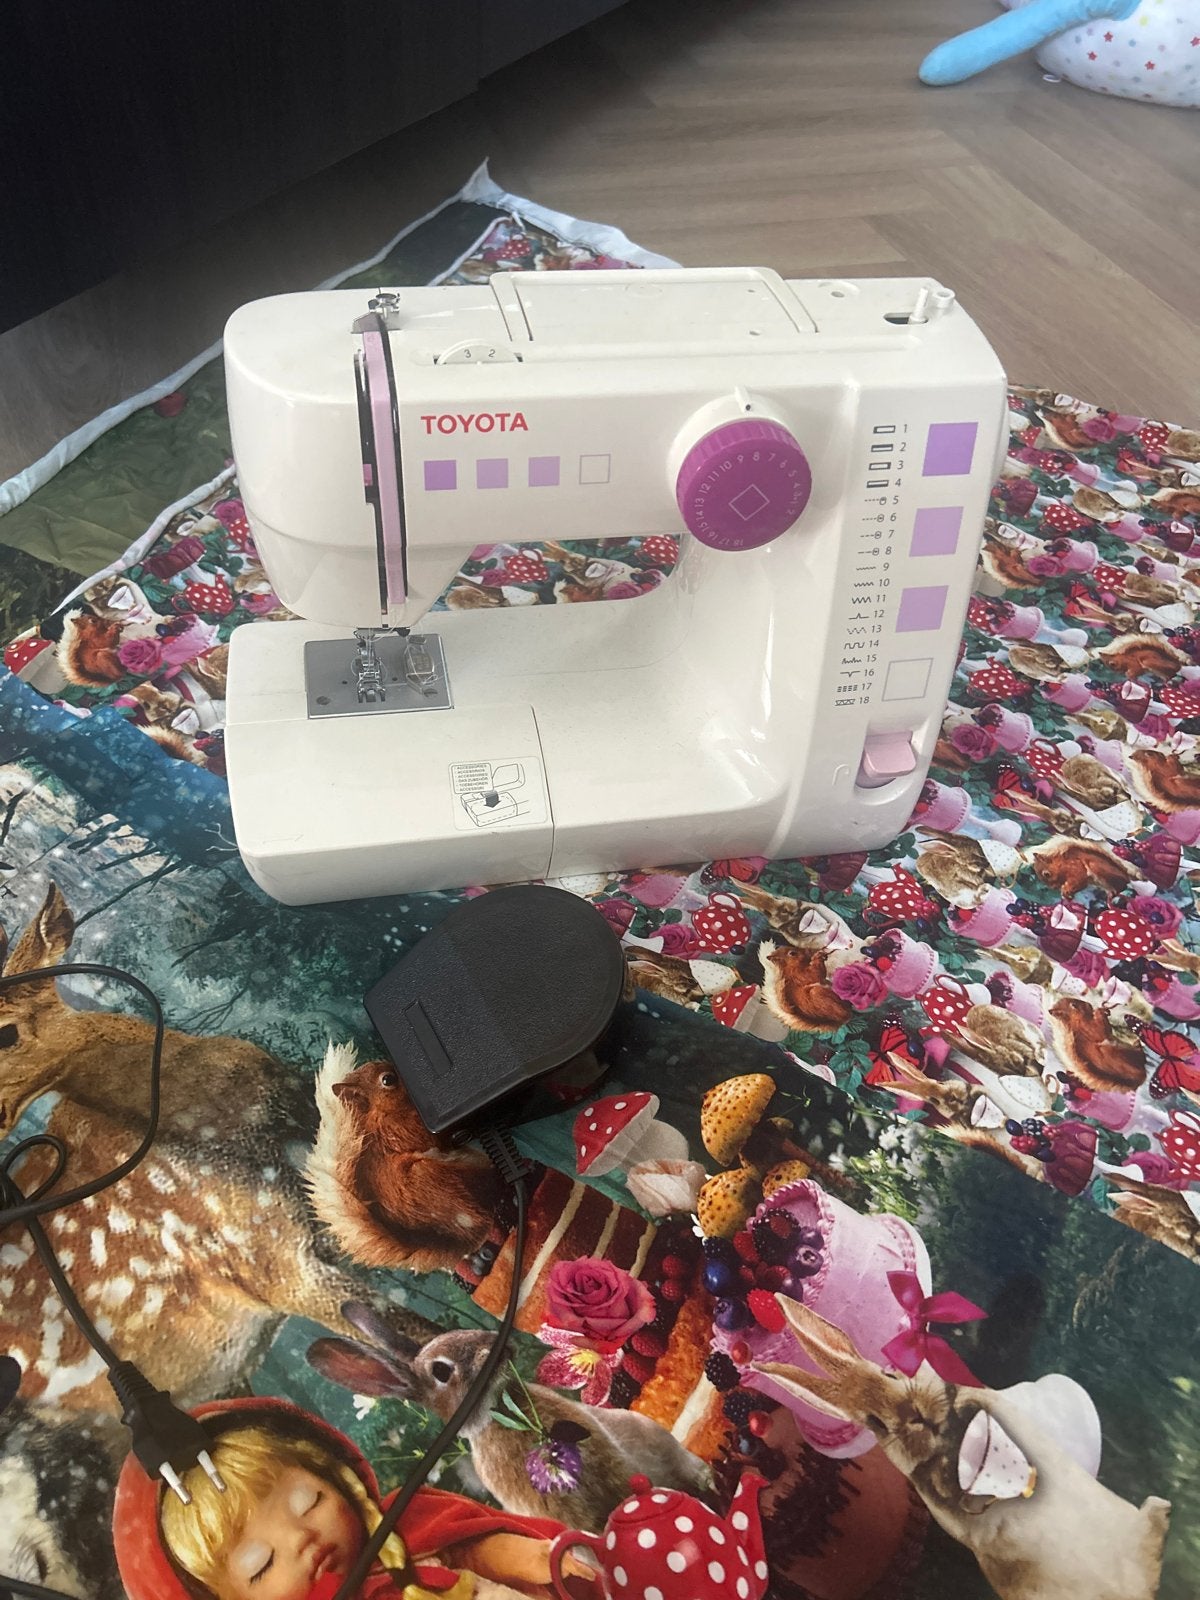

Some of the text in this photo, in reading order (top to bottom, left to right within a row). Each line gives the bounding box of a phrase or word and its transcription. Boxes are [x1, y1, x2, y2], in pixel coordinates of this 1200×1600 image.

[464, 349, 496, 358] 3 2
[420, 412, 528, 434] TOYOTA
[904, 424, 908, 433] 1
[900, 442, 906, 451] 2
[737, 454, 744, 463] 9
[752, 451, 760, 461] 8
[768, 452, 776, 461] 7
[720, 461, 732, 472] 10
[897, 460, 904, 469] 3
[708, 471, 719, 481] 11
[895, 478, 901, 487] 4
[699, 483, 711, 494] 12
[695, 497, 704, 507] 13
[893, 496, 899, 504] 5
[890, 513, 896, 521] 6
[888, 530, 894, 538] 7
[885, 546, 892, 555] 8
[883, 562, 889, 571] 9
[879, 578, 890, 587] 10
[877, 594, 886, 602] 11
[874, 610, 884, 618] 12
[872, 625, 882, 633] 13
[869, 640, 879, 648] 14
[866, 654, 877, 662] 15
